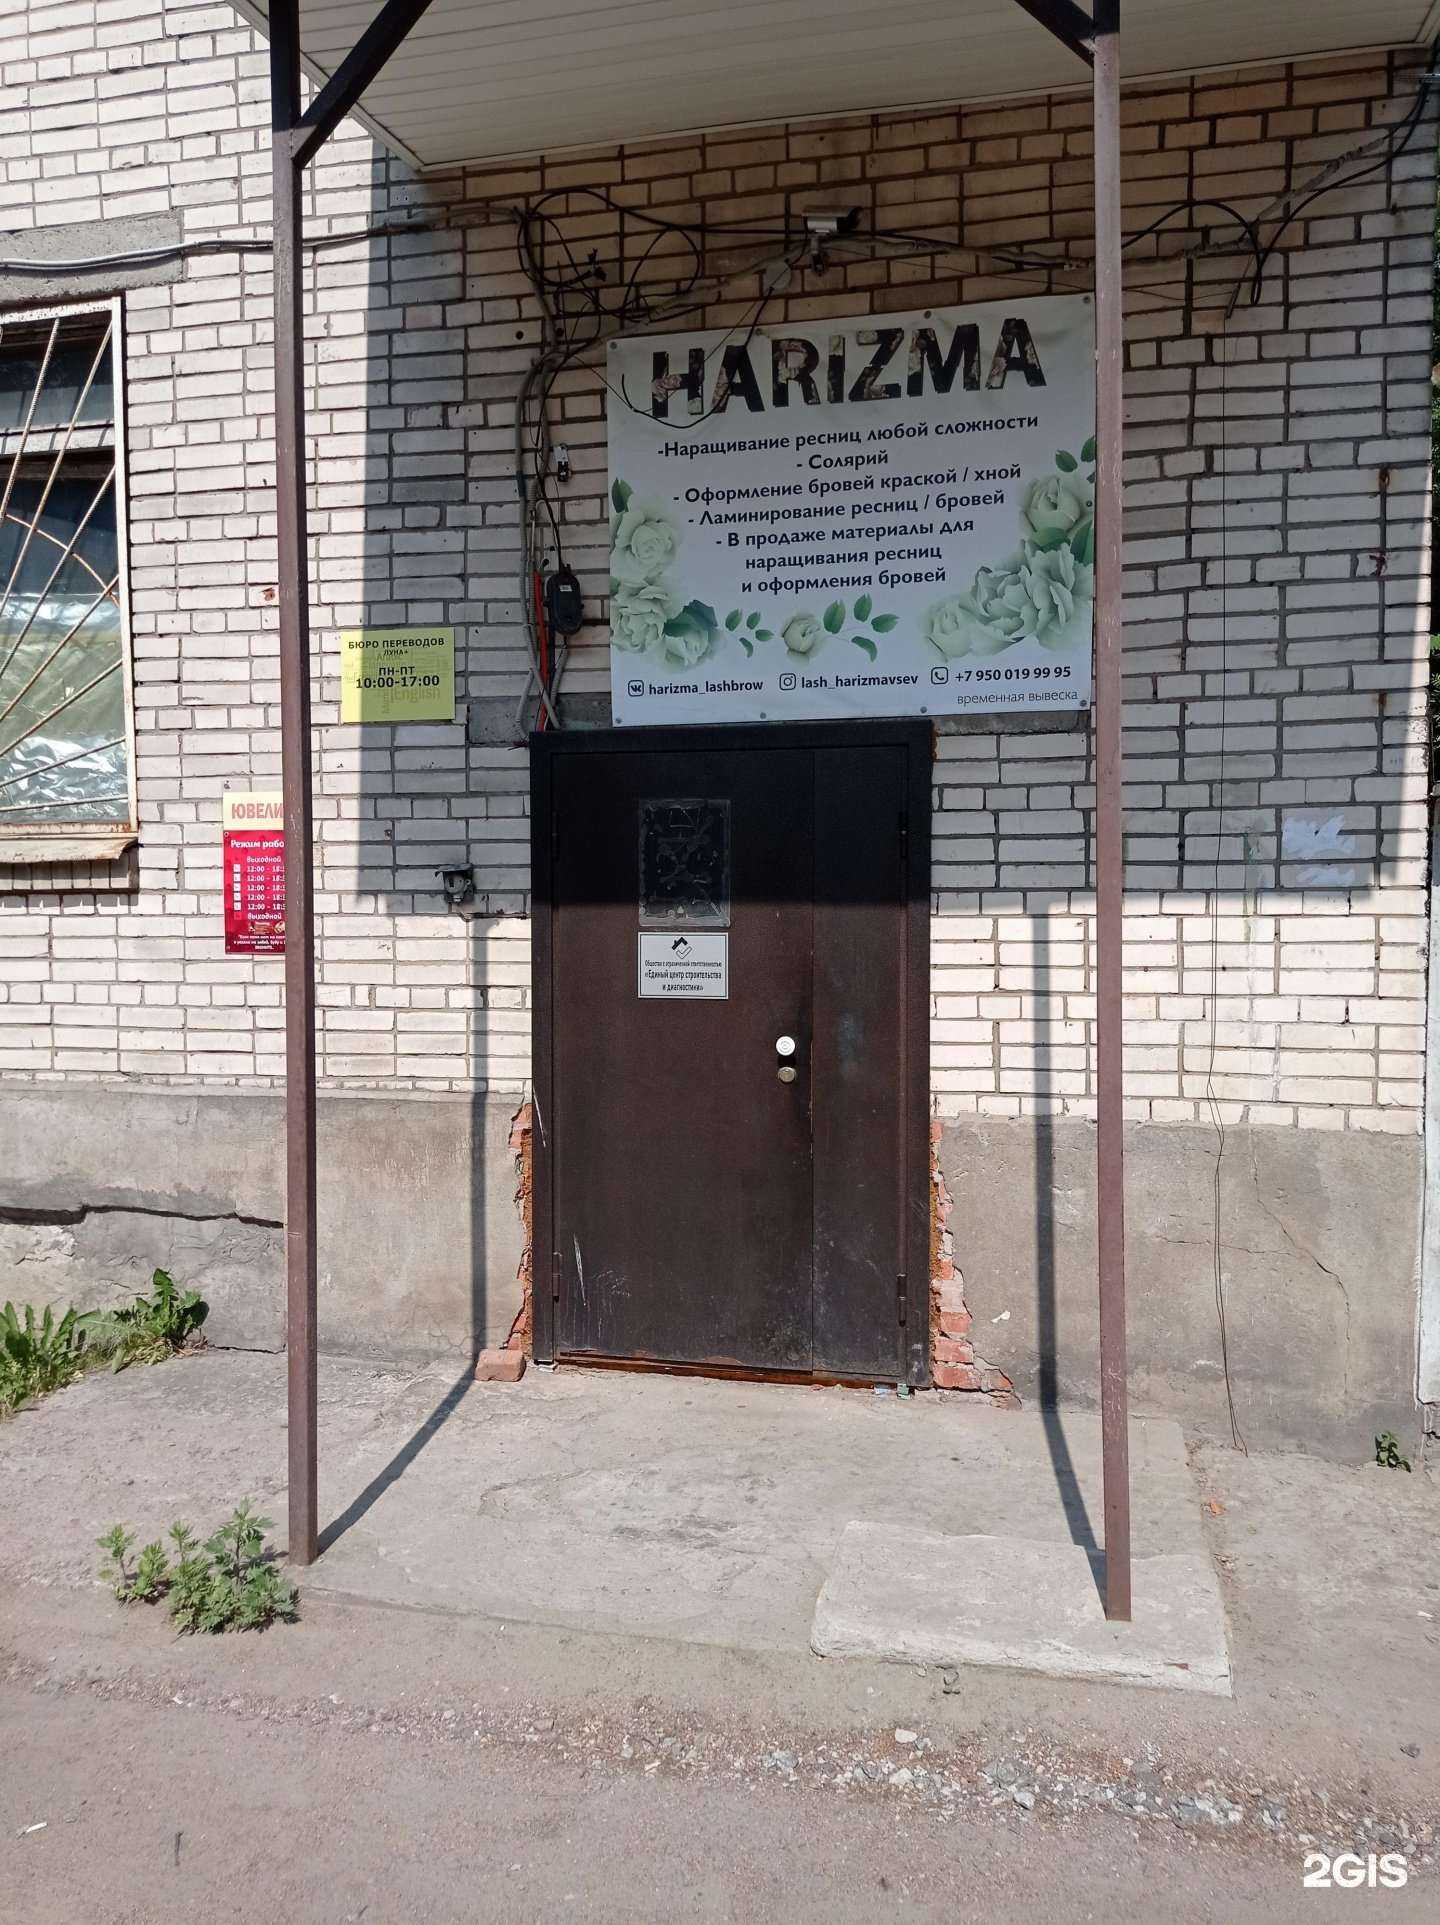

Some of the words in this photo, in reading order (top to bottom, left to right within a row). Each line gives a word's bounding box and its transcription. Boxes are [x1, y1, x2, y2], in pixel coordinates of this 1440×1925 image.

[651, 318, 1047, 418] HARIZMA
[795, 430, 862, 451] ресниц
[867, 422, 928, 441] любой
[935, 415, 1039, 435] сложности
[808, 450, 888, 470] Солярий
[685, 484, 803, 505] Оформление
[808, 475, 874, 497] бровей
[880, 469, 957, 492] краской
[974, 463, 1021, 481] хной
[699, 504, 846, 525] Ламинирование
[851, 499, 918, 519] ресниц
[935, 490, 1005, 512] бровей
[728, 532, 739, 547] В
[745, 530, 826, 549] продаже
[831, 523, 934, 541] материалы
[939, 520, 974, 535] для
[745, 550, 869, 572] наращивания
[874, 547, 942, 565] ресниц
[742, 581, 752, 593] и
[757, 572, 873, 595] оформления
[878, 567, 947, 588] бровей
[348, 641, 379, 649] БЮРО
[382, 637, 445, 648] ПЕРЕВОДОВ
[379, 666, 415, 676] ПН-ПТ
[955, 671, 973, 683] +7
[975, 669, 1001, 681] 950
[1004, 668, 1030, 680] 019
[1033, 667, 1051, 679] 99
[1054, 666, 1071, 678] 95
[356, 675, 440, 689] 10:00-17:00
[649, 679, 764, 696] harizma_lashbrow
[801, 674, 918, 690] lash_harizmavsev
[957, 693, 1025, 707] временная
[1028, 690, 1078, 702] вывеска
